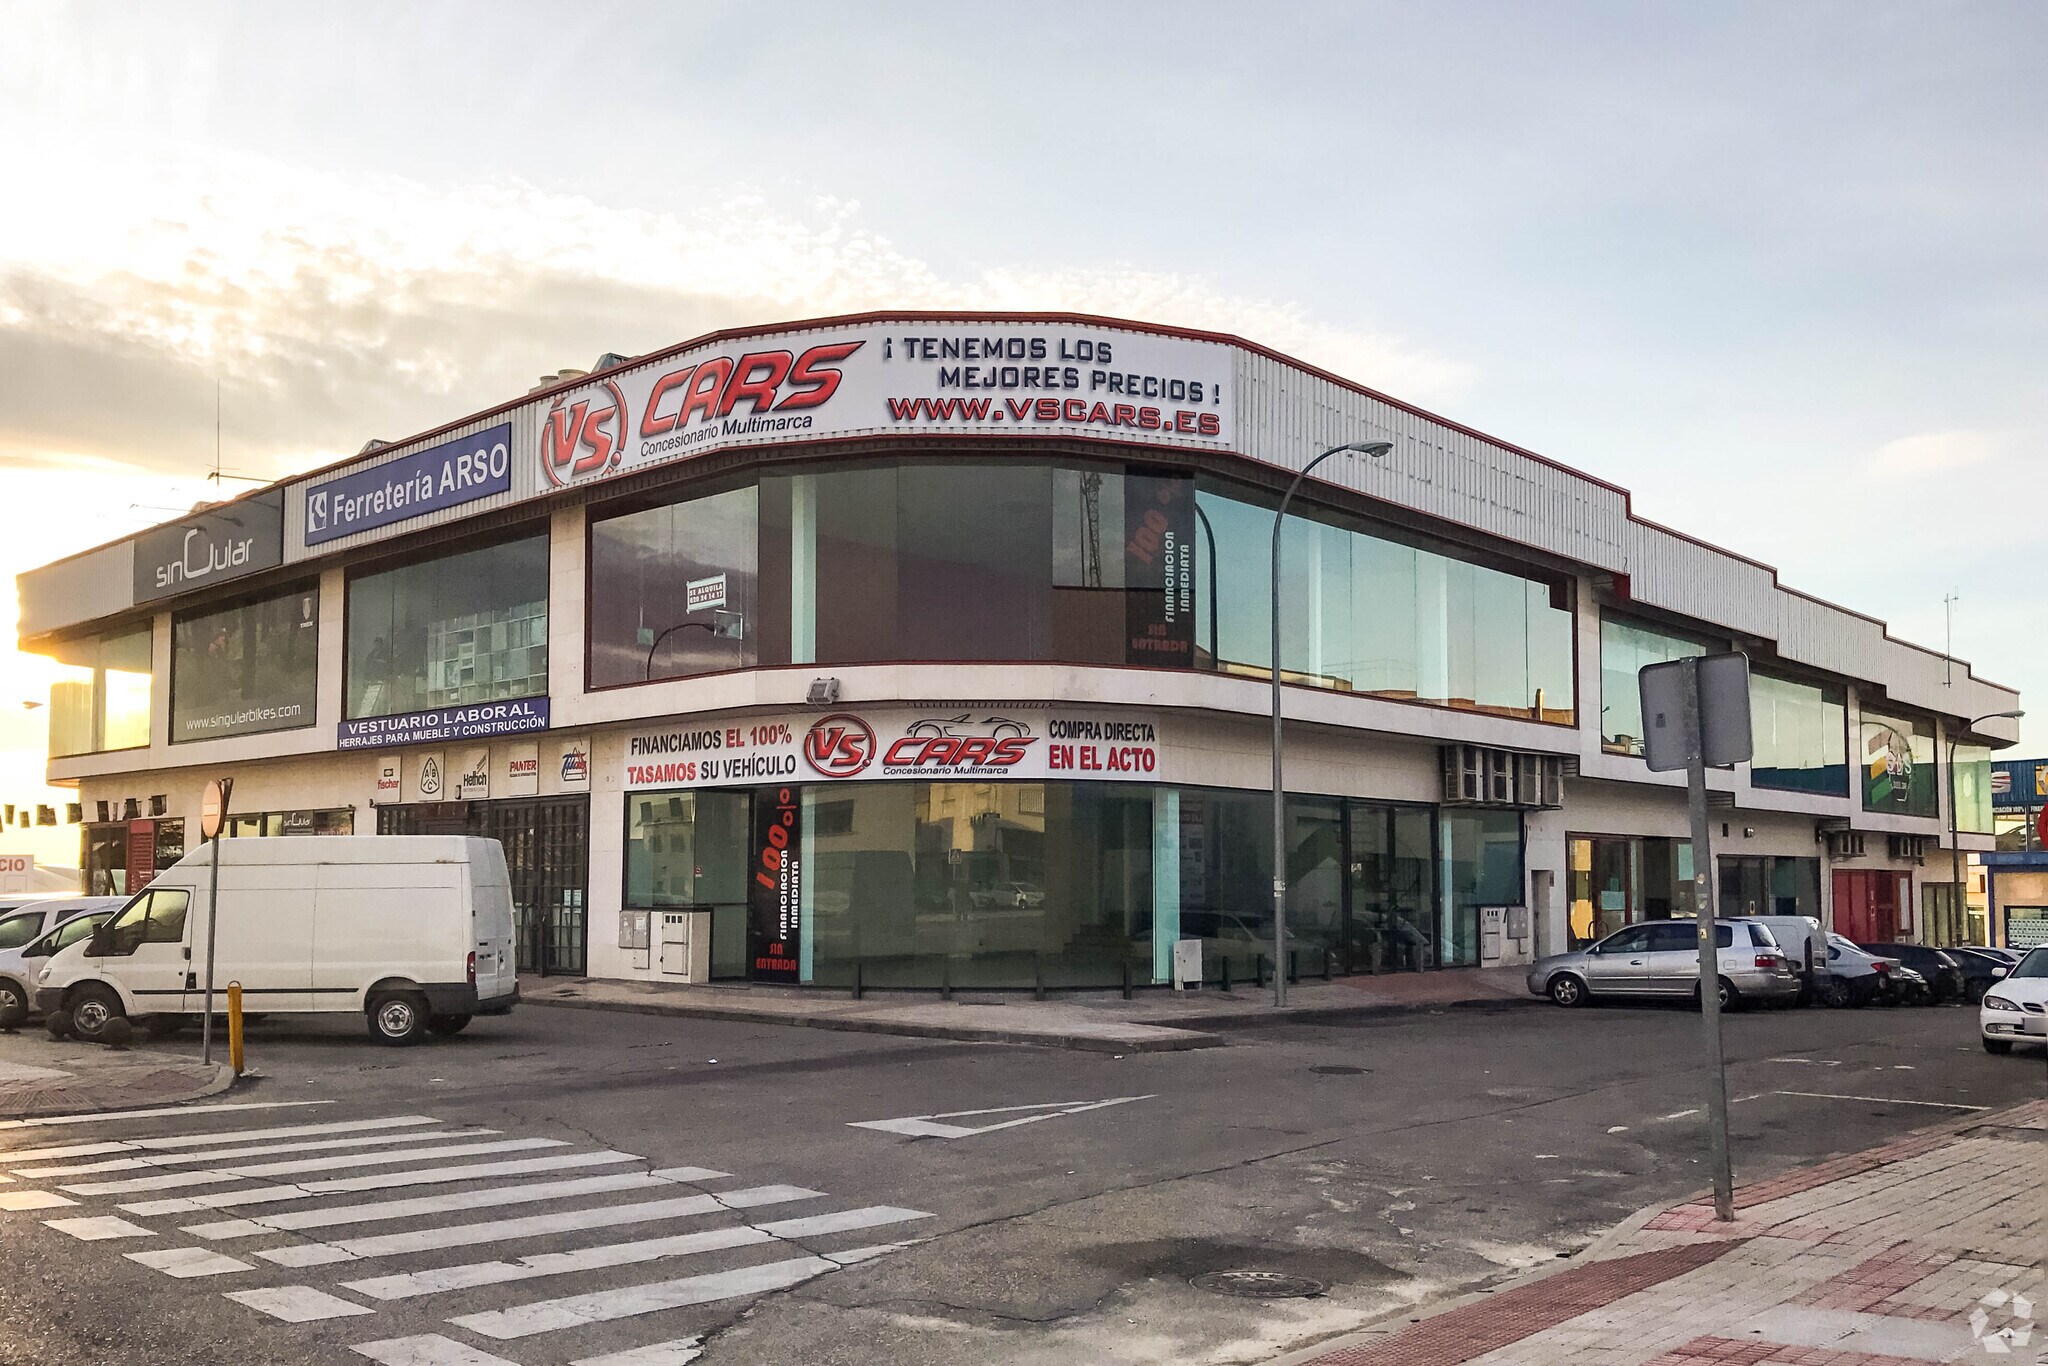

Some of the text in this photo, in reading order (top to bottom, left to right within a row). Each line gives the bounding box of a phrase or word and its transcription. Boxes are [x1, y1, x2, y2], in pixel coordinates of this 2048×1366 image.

[904, 337, 1047, 360] TENEMOS
[1060, 338, 1112, 363] LOS
[639, 340, 867, 439] CARS
[940, 366, 1080, 389] MEJORES
[1092, 370, 1204, 402] PRECIOS
[887, 397, 1221, 436] WWW.VSCARS.ES
[640, 415, 813, 457] Concesionario Multimarca
[333, 442, 508, 526] Ferretería ARSO
[1164, 531, 1175, 623] FINANCIACION
[1180, 544, 1190, 613] INMEDIATA
[186, 703, 301, 731] www.singularbikes.com
[339, 715, 546, 748] HERRAJES PARA MUEBLE Y CONSTRUCCIÓN
[348, 702, 535, 735] VESTUARIO LABORAL
[1050, 719, 1155, 742] COMPRA DIRECTA
[631, 723, 793, 755] FINANCIAMOS EL 100%
[882, 736, 1040, 766] CARS
[628, 752, 796, 785] TASAMOS SU VEHÍCULO
[882, 766, 1008, 775] Concesionario Multimarca
[1049, 745, 1156, 772] EN EL ACTO
[377, 779, 399, 789] fischer
[779, 850, 788, 940] FINANCIACION
[791, 861, 799, 929] INMEDIATA
[756, 957, 797, 971] ENTRADA
[769, 943, 783, 955] SIN
